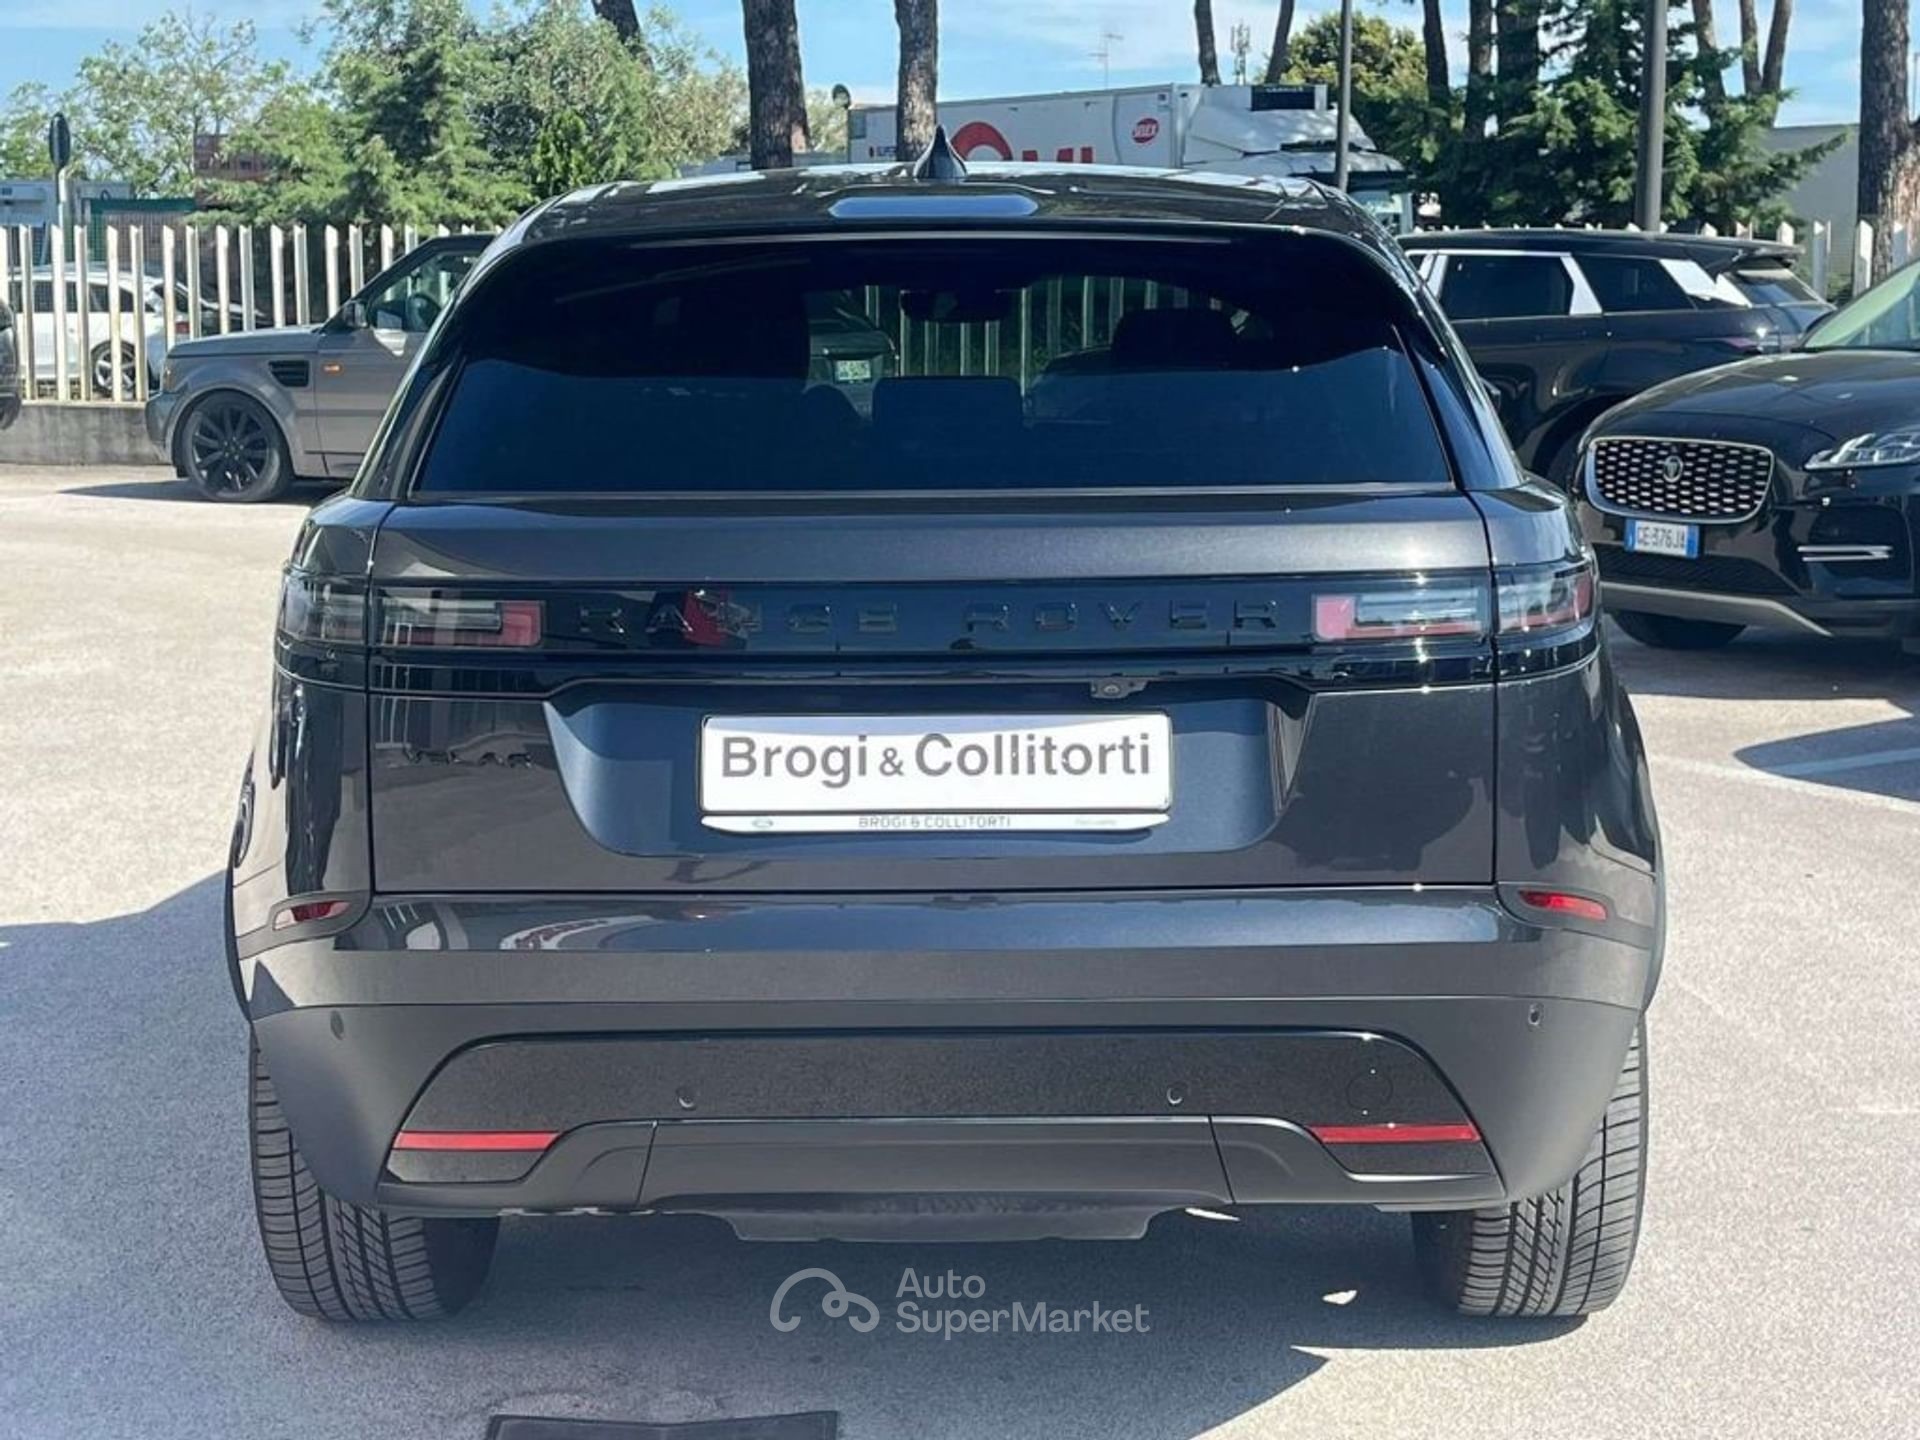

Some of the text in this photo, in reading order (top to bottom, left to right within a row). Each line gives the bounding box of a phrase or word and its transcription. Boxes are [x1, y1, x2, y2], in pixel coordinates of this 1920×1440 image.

[965, 600, 1276, 632] ROVER
[722, 732, 1149, 788] Brogi & Collitorti
[858, 815, 906, 828] BROGI
[924, 815, 1012, 828] COLLITORTI
